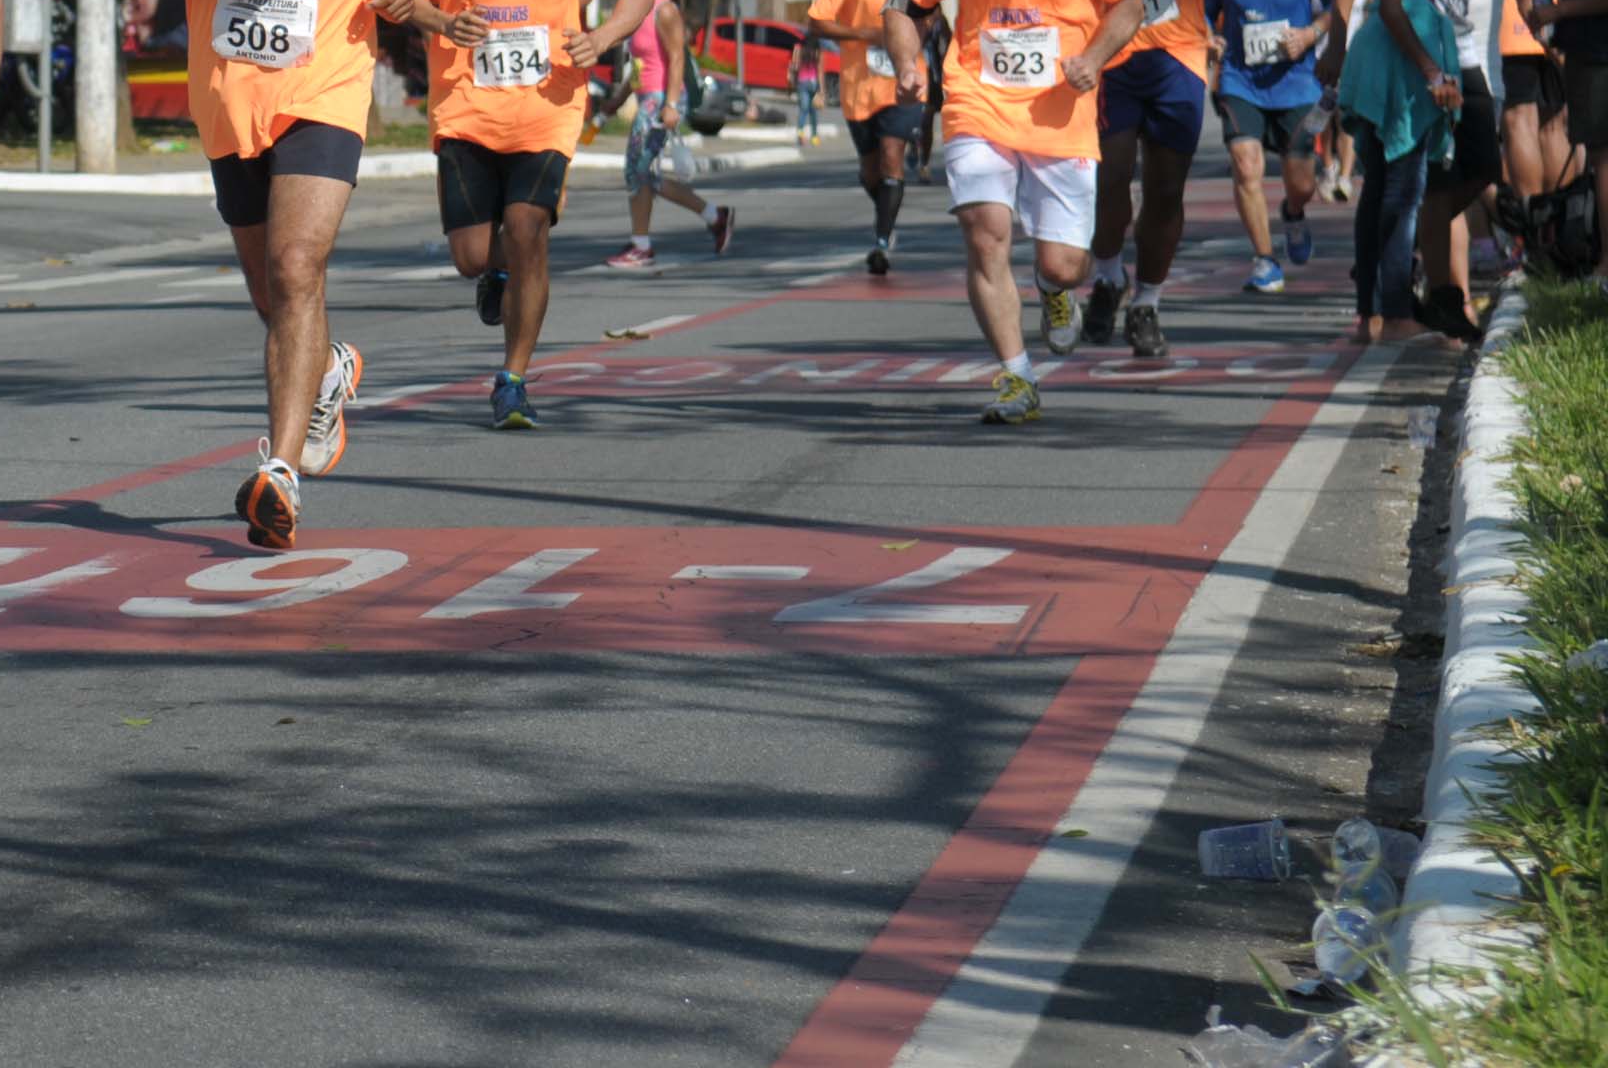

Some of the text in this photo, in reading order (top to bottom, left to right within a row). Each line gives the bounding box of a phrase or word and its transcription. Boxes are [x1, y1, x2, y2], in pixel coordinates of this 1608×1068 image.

[227, 17, 290, 54] 508
[235, 49, 277, 62] ANTONIO
[477, 49, 543, 75] 1134
[993, 51, 1045, 75] 623
